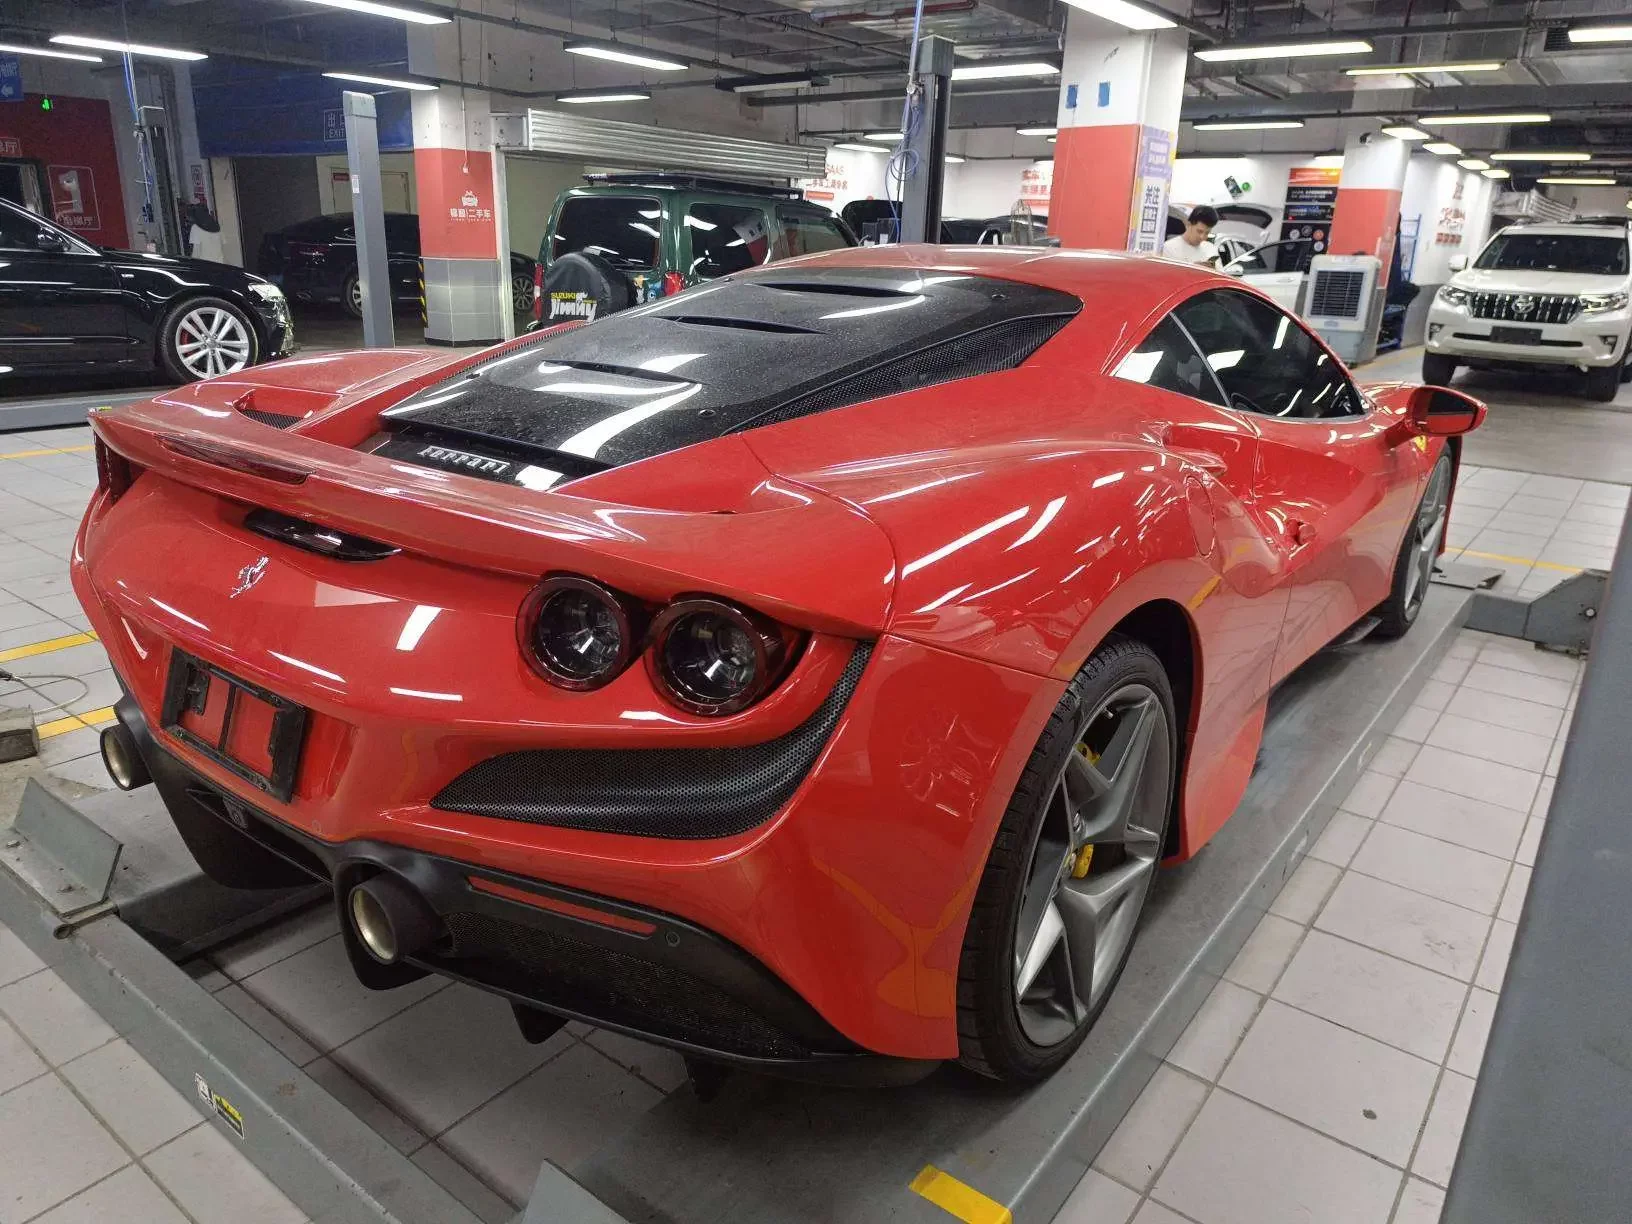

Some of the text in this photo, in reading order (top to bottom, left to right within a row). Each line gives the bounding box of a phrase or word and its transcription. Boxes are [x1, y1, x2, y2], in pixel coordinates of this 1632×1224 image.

[329, 129, 345, 139] EXIT
[551, 292, 576, 300] SUZUKI
[416, 445, 511, 474] Ferrari
